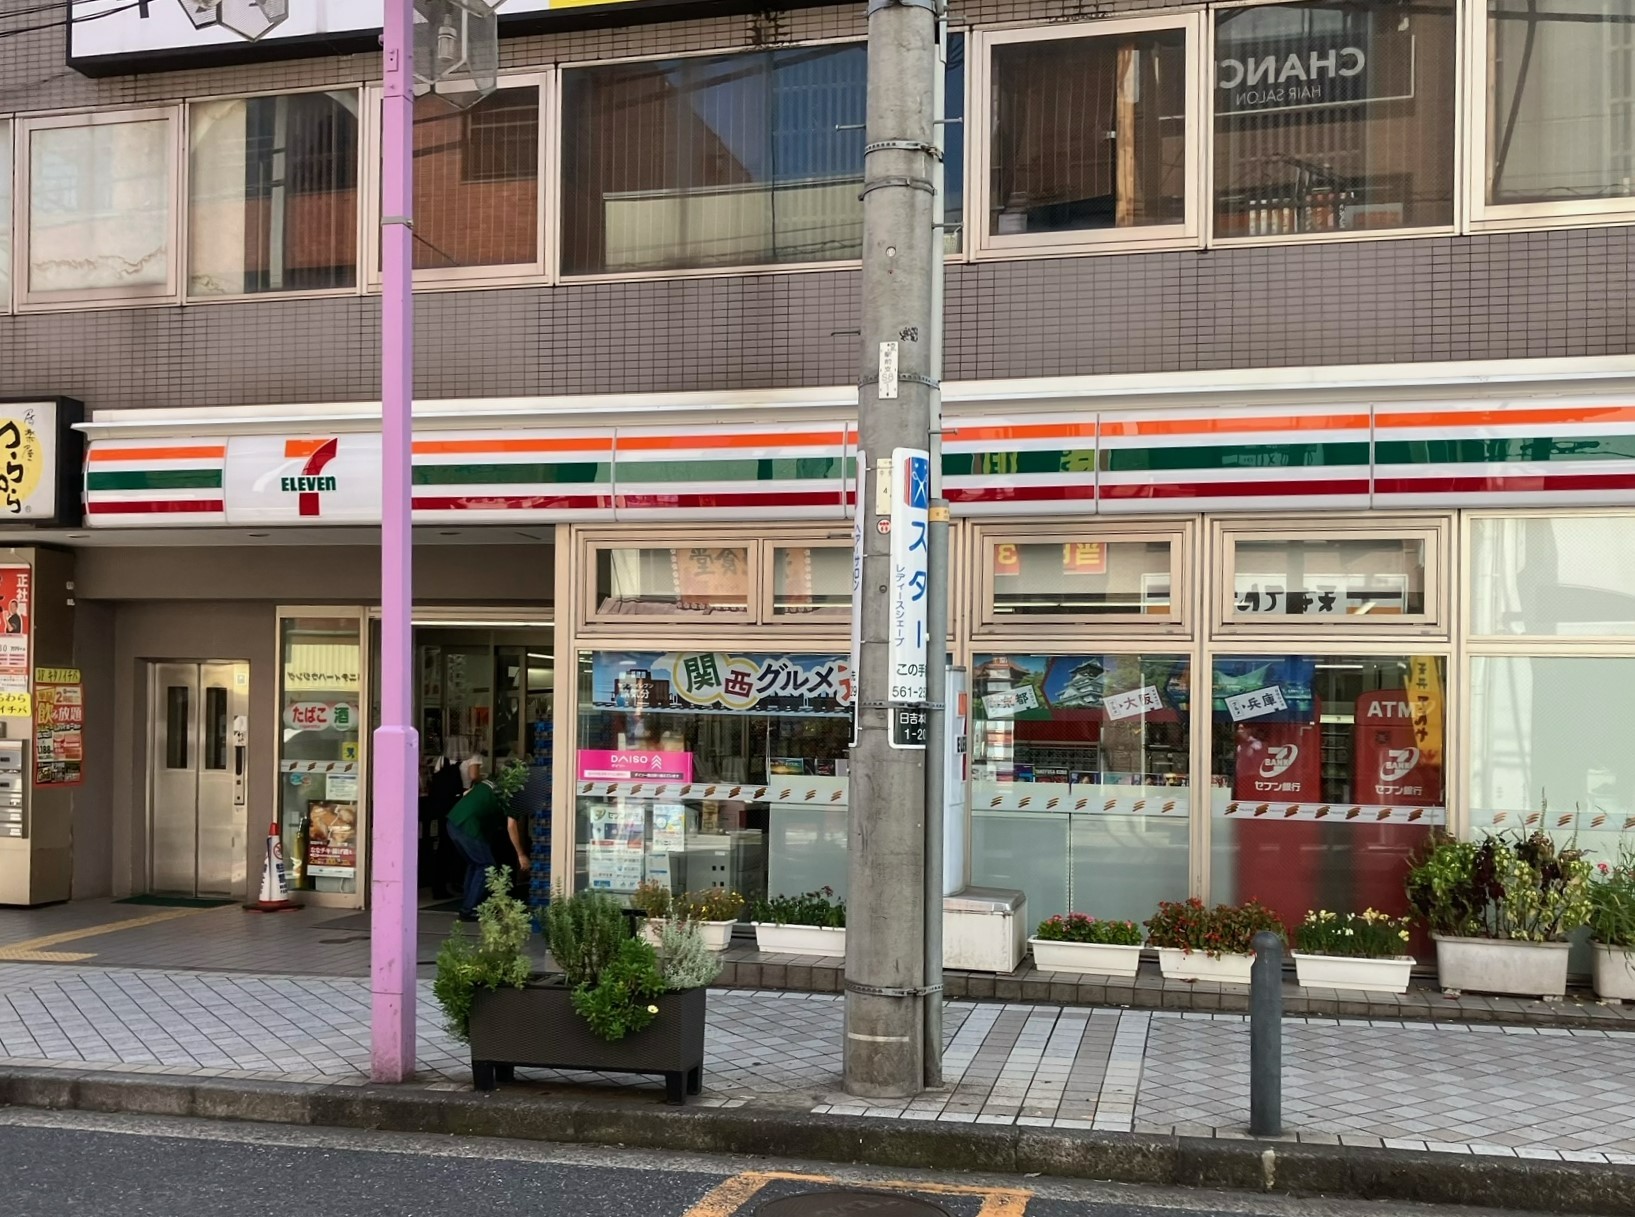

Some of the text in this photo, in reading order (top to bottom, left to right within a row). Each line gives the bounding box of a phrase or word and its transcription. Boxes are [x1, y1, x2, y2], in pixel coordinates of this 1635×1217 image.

[284, 437, 338, 516] 7
[908, 521, 928, 649] スター
[895, 564, 905, 647] レディースシェーブ
[1124, 693, 1153, 710] 大阪
[1247, 693, 1277, 711] 兵庫
[1367, 701, 1415, 718] ATM
[292, 706, 327, 723] たばこ
[333, 707, 349, 723] 酒
[611, 755, 648, 764] DAISO
[1255, 780, 1301, 792] セブン銀行
[1375, 784, 1422, 796] セブン銀行
